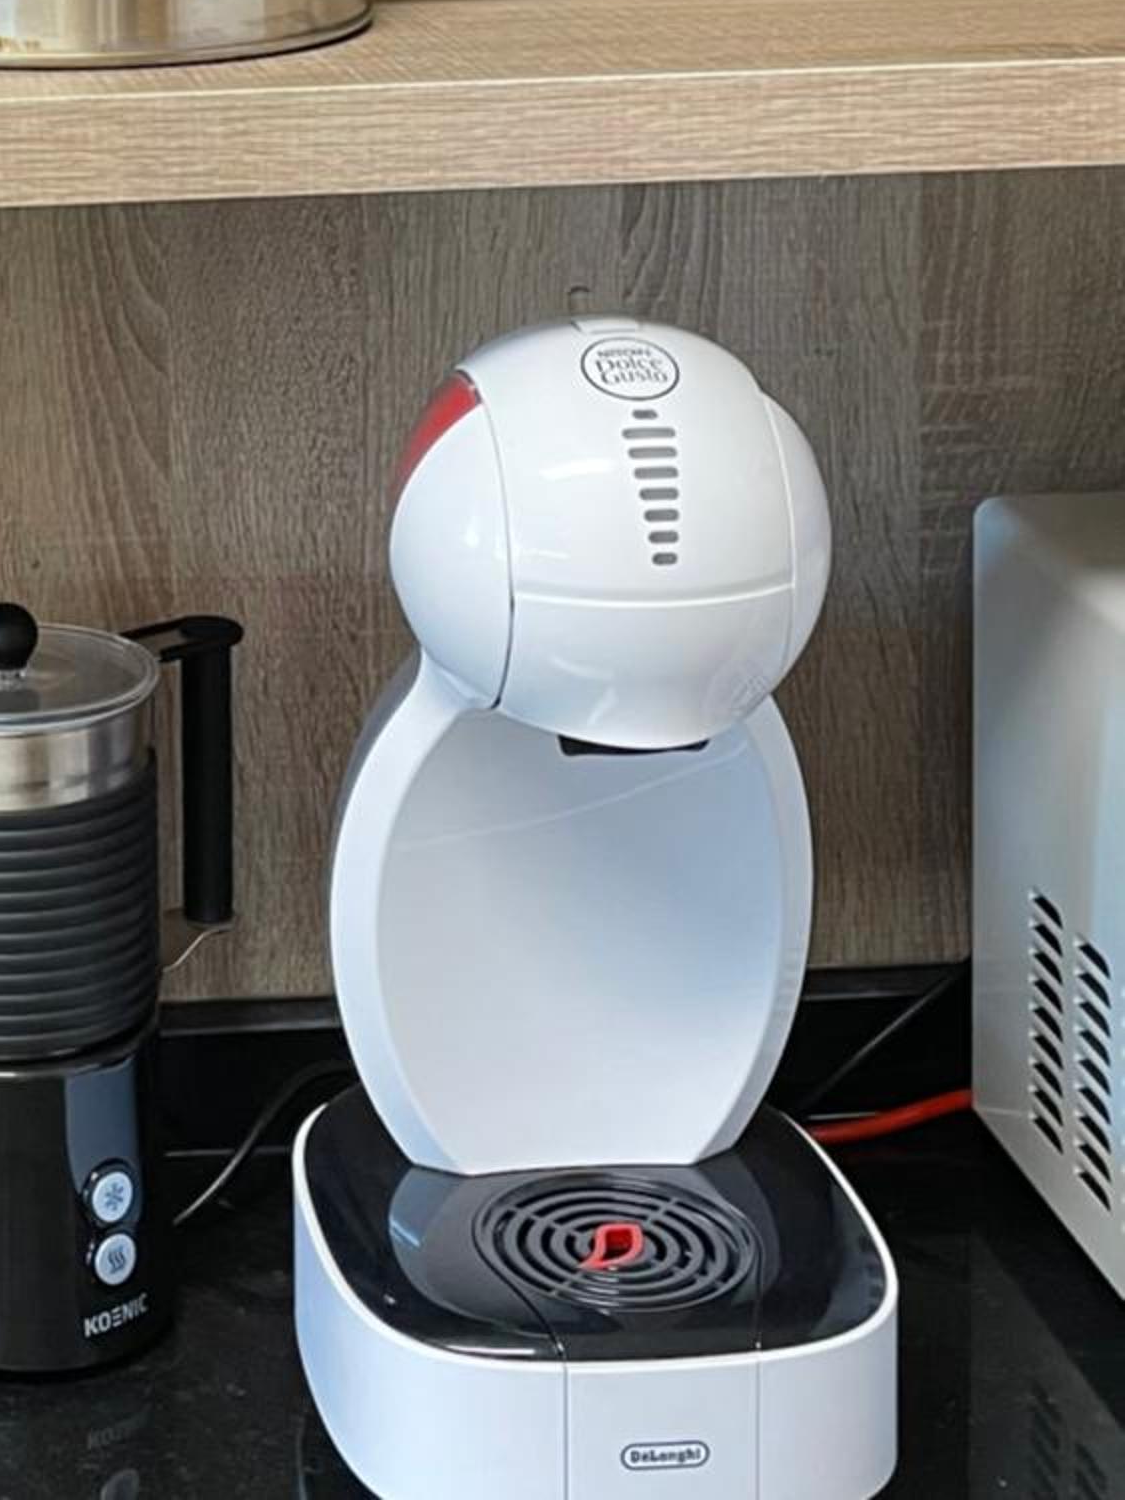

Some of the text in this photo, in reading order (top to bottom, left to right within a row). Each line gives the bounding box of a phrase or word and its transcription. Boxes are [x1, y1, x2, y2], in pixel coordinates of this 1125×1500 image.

[595, 356, 663, 373] Dolce
[600, 370, 668, 385] Gusto
[84, 1292, 148, 1337] KOENIC
